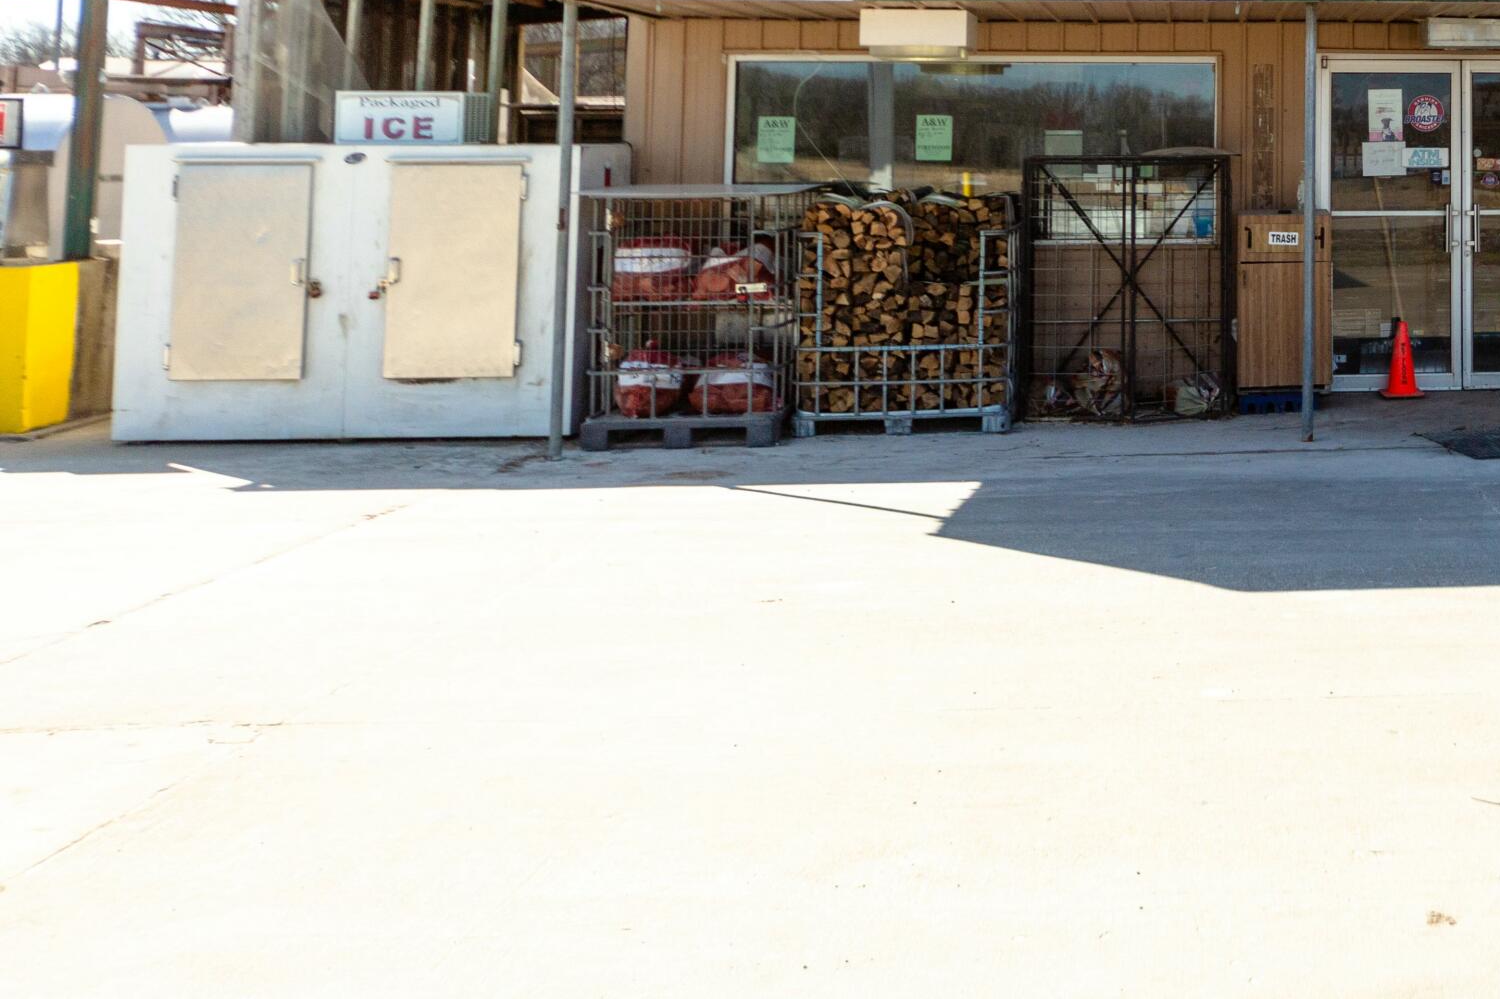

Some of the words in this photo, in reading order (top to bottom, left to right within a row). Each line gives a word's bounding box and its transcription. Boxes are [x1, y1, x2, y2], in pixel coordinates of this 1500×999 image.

[360, 96, 440, 109] Packaged
[364, 115, 434, 140] ICE
[1410, 149, 1441, 159] ATM
[1408, 158, 1442, 166] INSIDE
[1271, 233, 1297, 244] TRASH
